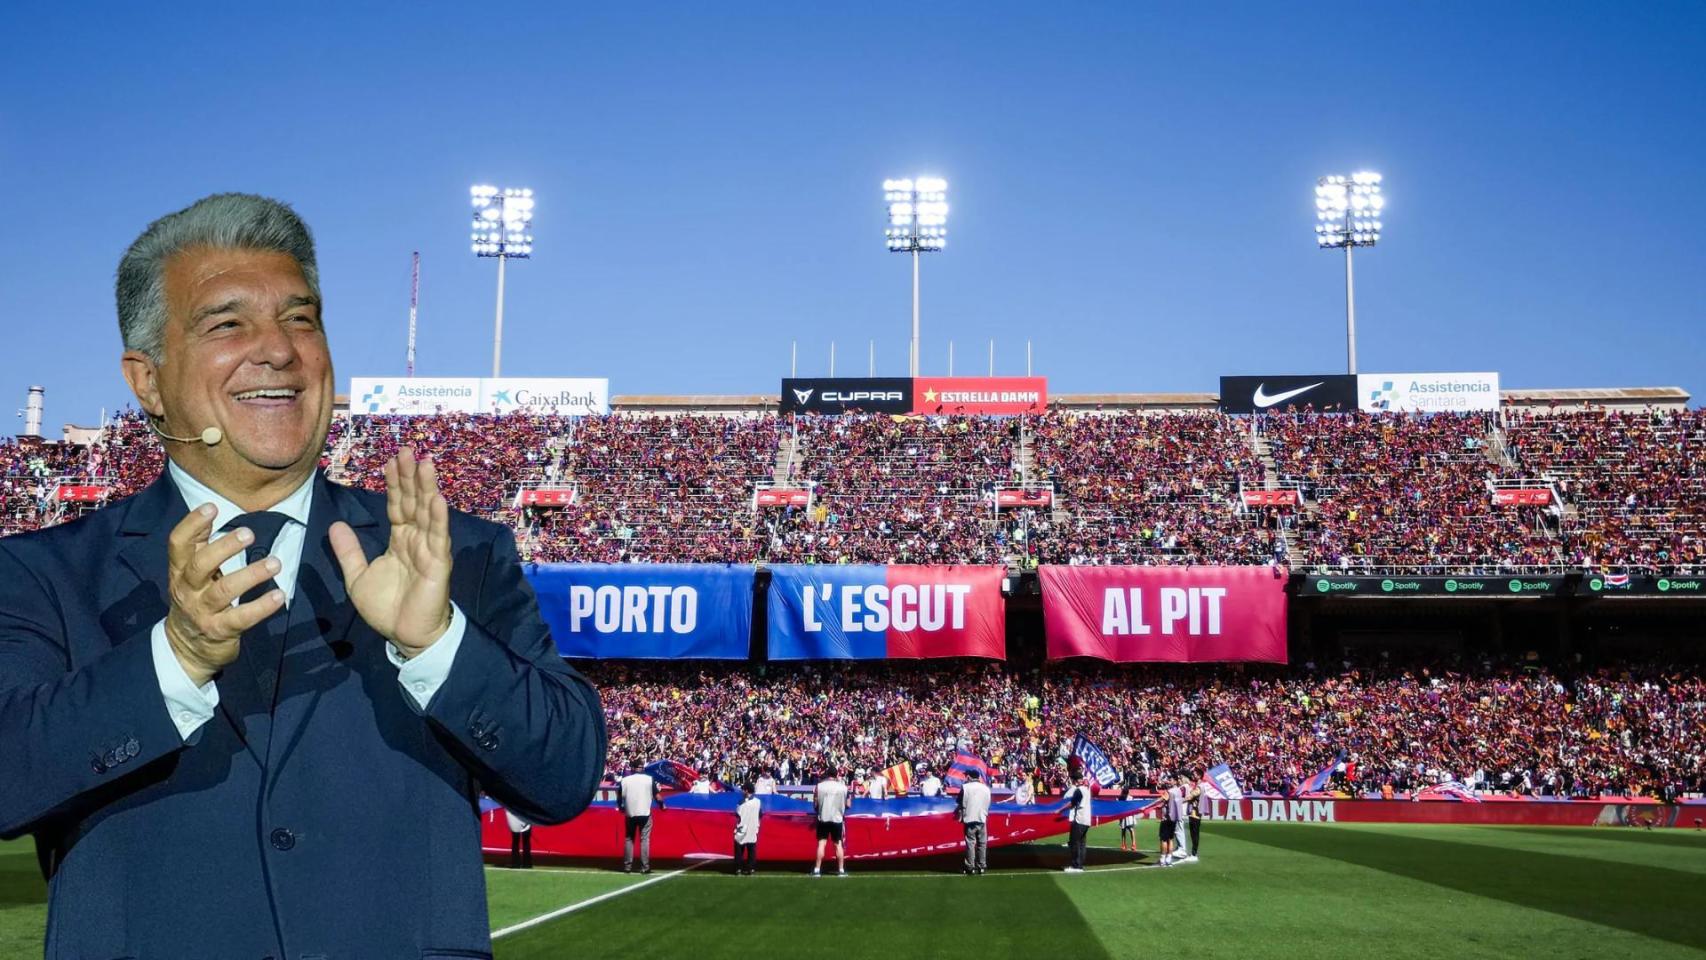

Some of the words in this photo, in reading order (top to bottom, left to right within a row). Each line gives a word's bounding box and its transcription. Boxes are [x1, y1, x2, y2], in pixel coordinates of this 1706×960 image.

[515, 390, 597, 406] CaixaBank
[821, 391, 903, 401] CUPRA
[941, 391, 998, 403] ESTRELLA
[1001, 391, 1039, 403] DAMM
[1331, 582, 1357, 590] Spotify
[1394, 582, 1420, 590] Spotify
[1458, 582, 1484, 590] Spotify
[1522, 582, 1550, 590] Spotify
[1671, 581, 1700, 590] Spotify
[570, 585, 698, 633] PORTO
[803, 584, 971, 633] L'ESCUT
[1102, 587, 1151, 635] AL
[1160, 587, 1227, 635] PIT
[1251, 799, 1336, 822] DAMM
